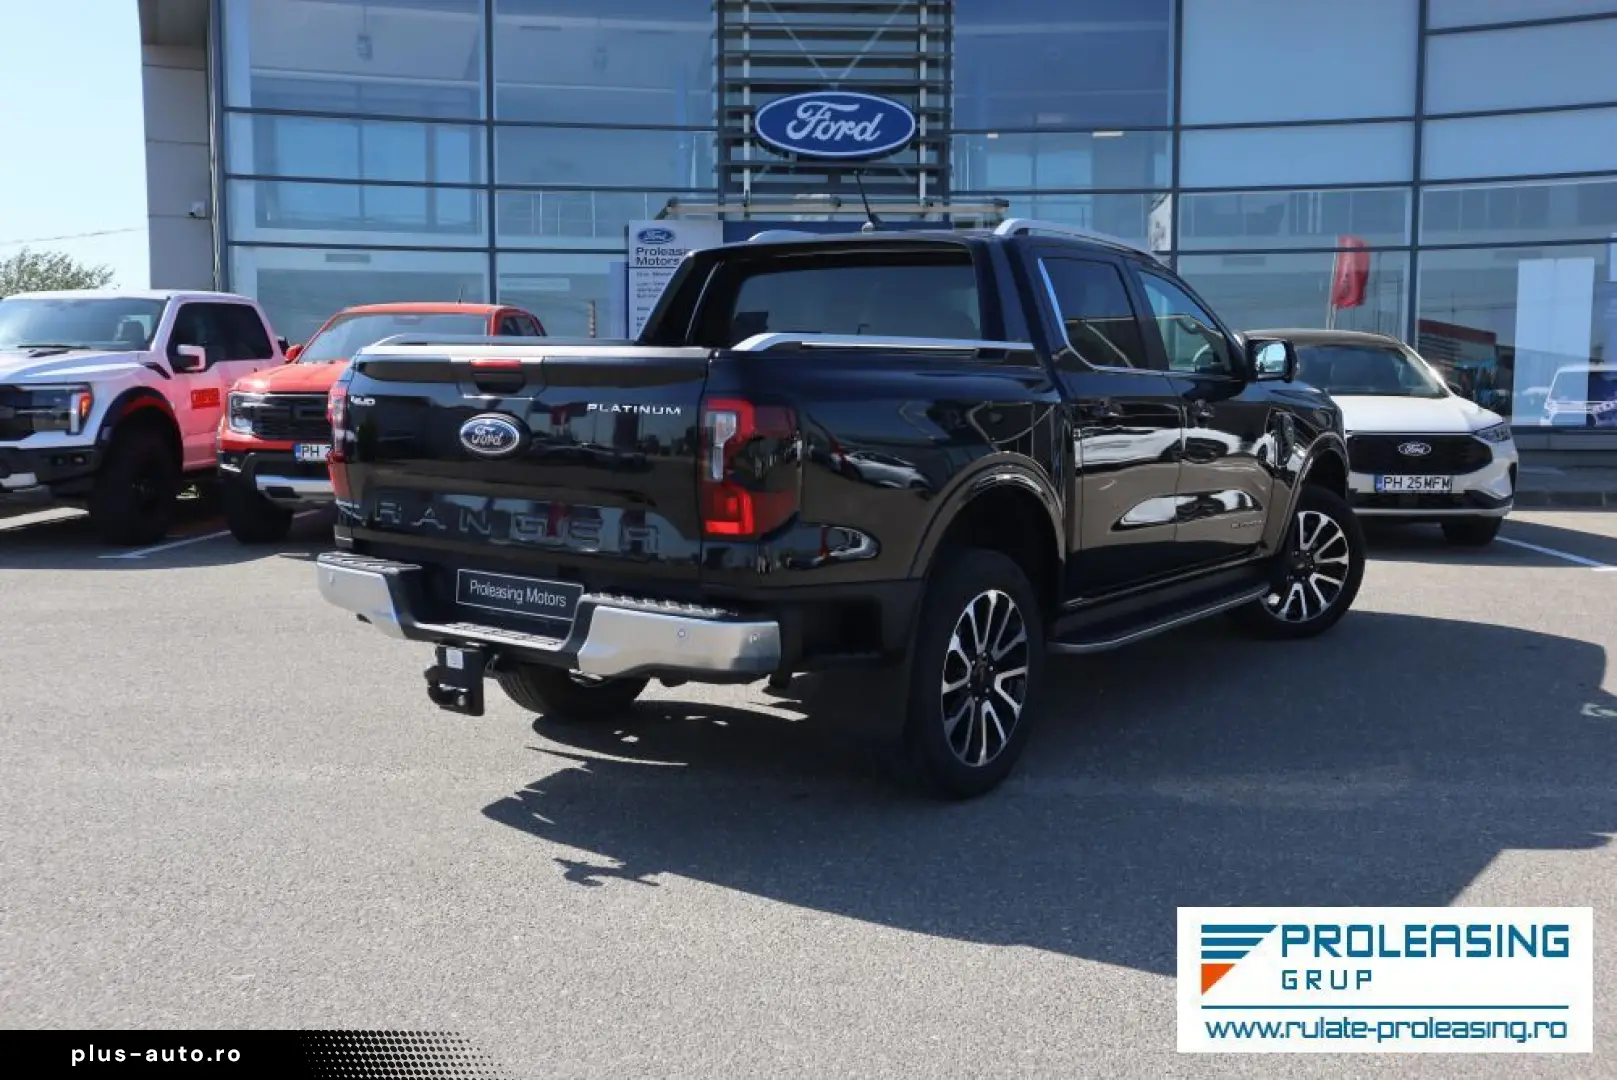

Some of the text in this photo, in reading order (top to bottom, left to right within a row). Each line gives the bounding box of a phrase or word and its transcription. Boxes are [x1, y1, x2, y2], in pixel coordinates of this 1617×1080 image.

[786, 101, 884, 142] Ford
[636, 256, 680, 266] Motors
[586, 403, 682, 415] PLATINUM
[301, 445, 319, 457] PH
[1383, 476, 1403, 489] PH
[1407, 476, 1422, 489] 25
[375, 499, 660, 556] RANGER
[469, 579, 567, 607] Proleasing Motors
